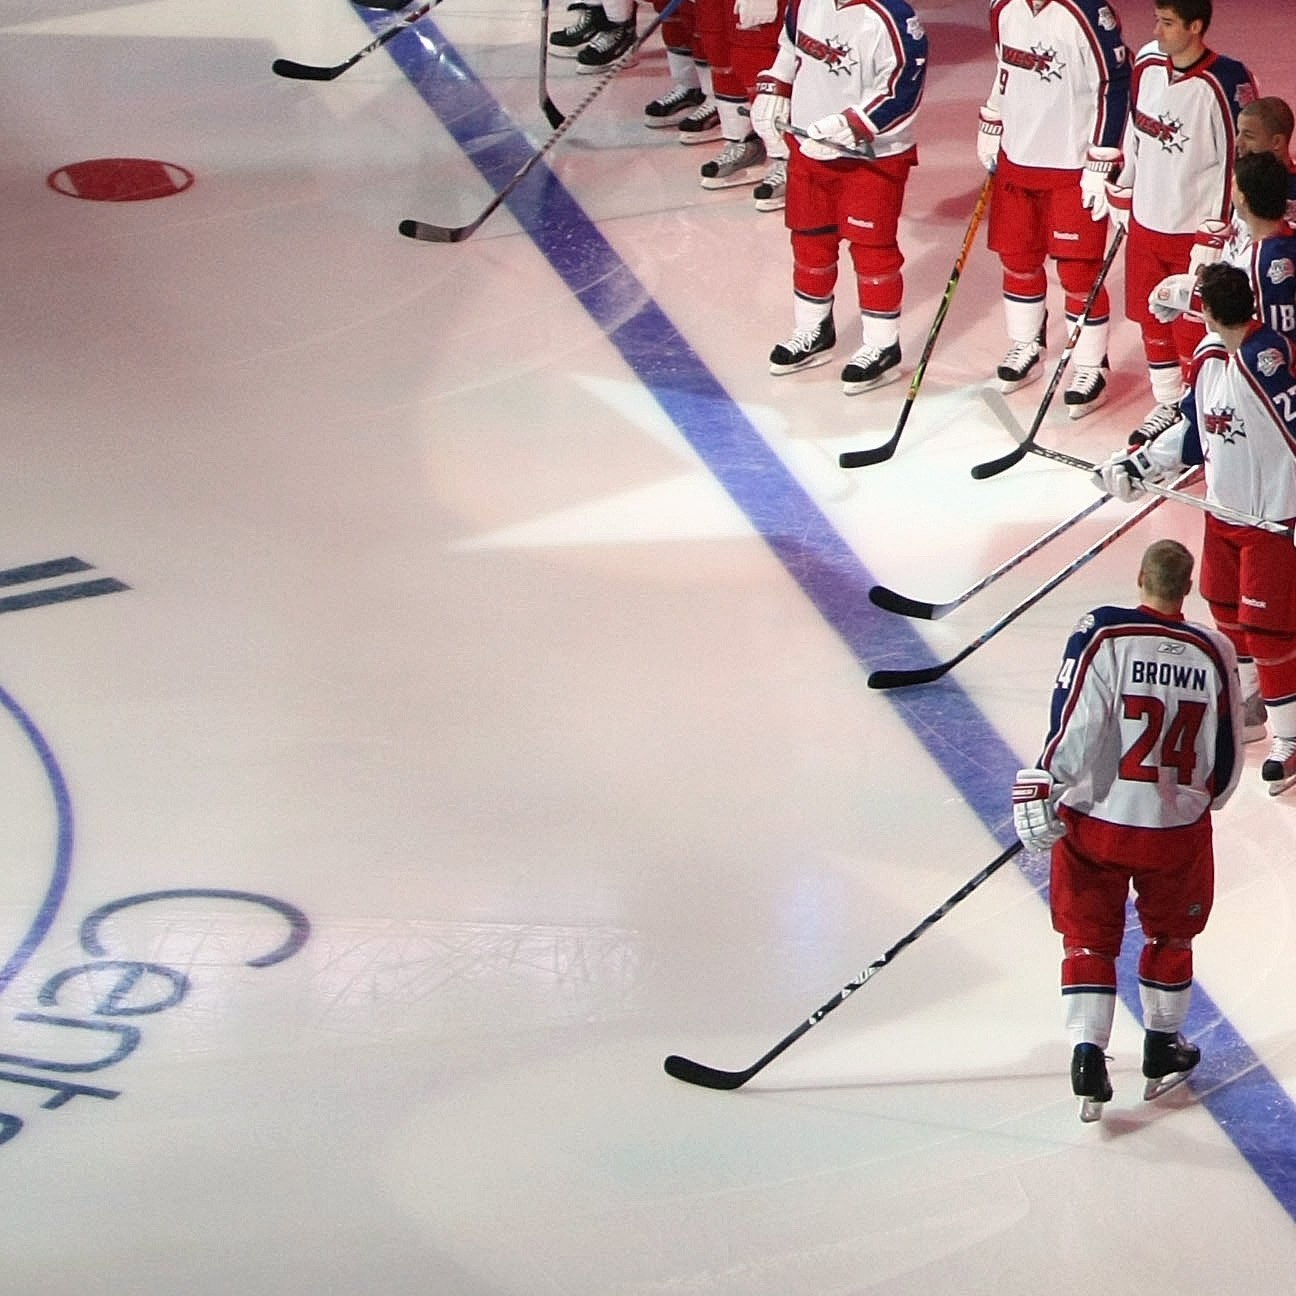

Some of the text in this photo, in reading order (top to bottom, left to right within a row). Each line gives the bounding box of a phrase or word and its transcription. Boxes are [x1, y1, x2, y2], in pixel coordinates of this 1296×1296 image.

[1269, 304, 1296, 333] 18
[1131, 660, 1207, 692] BROWN
[1118, 693, 1209, 786] 24
